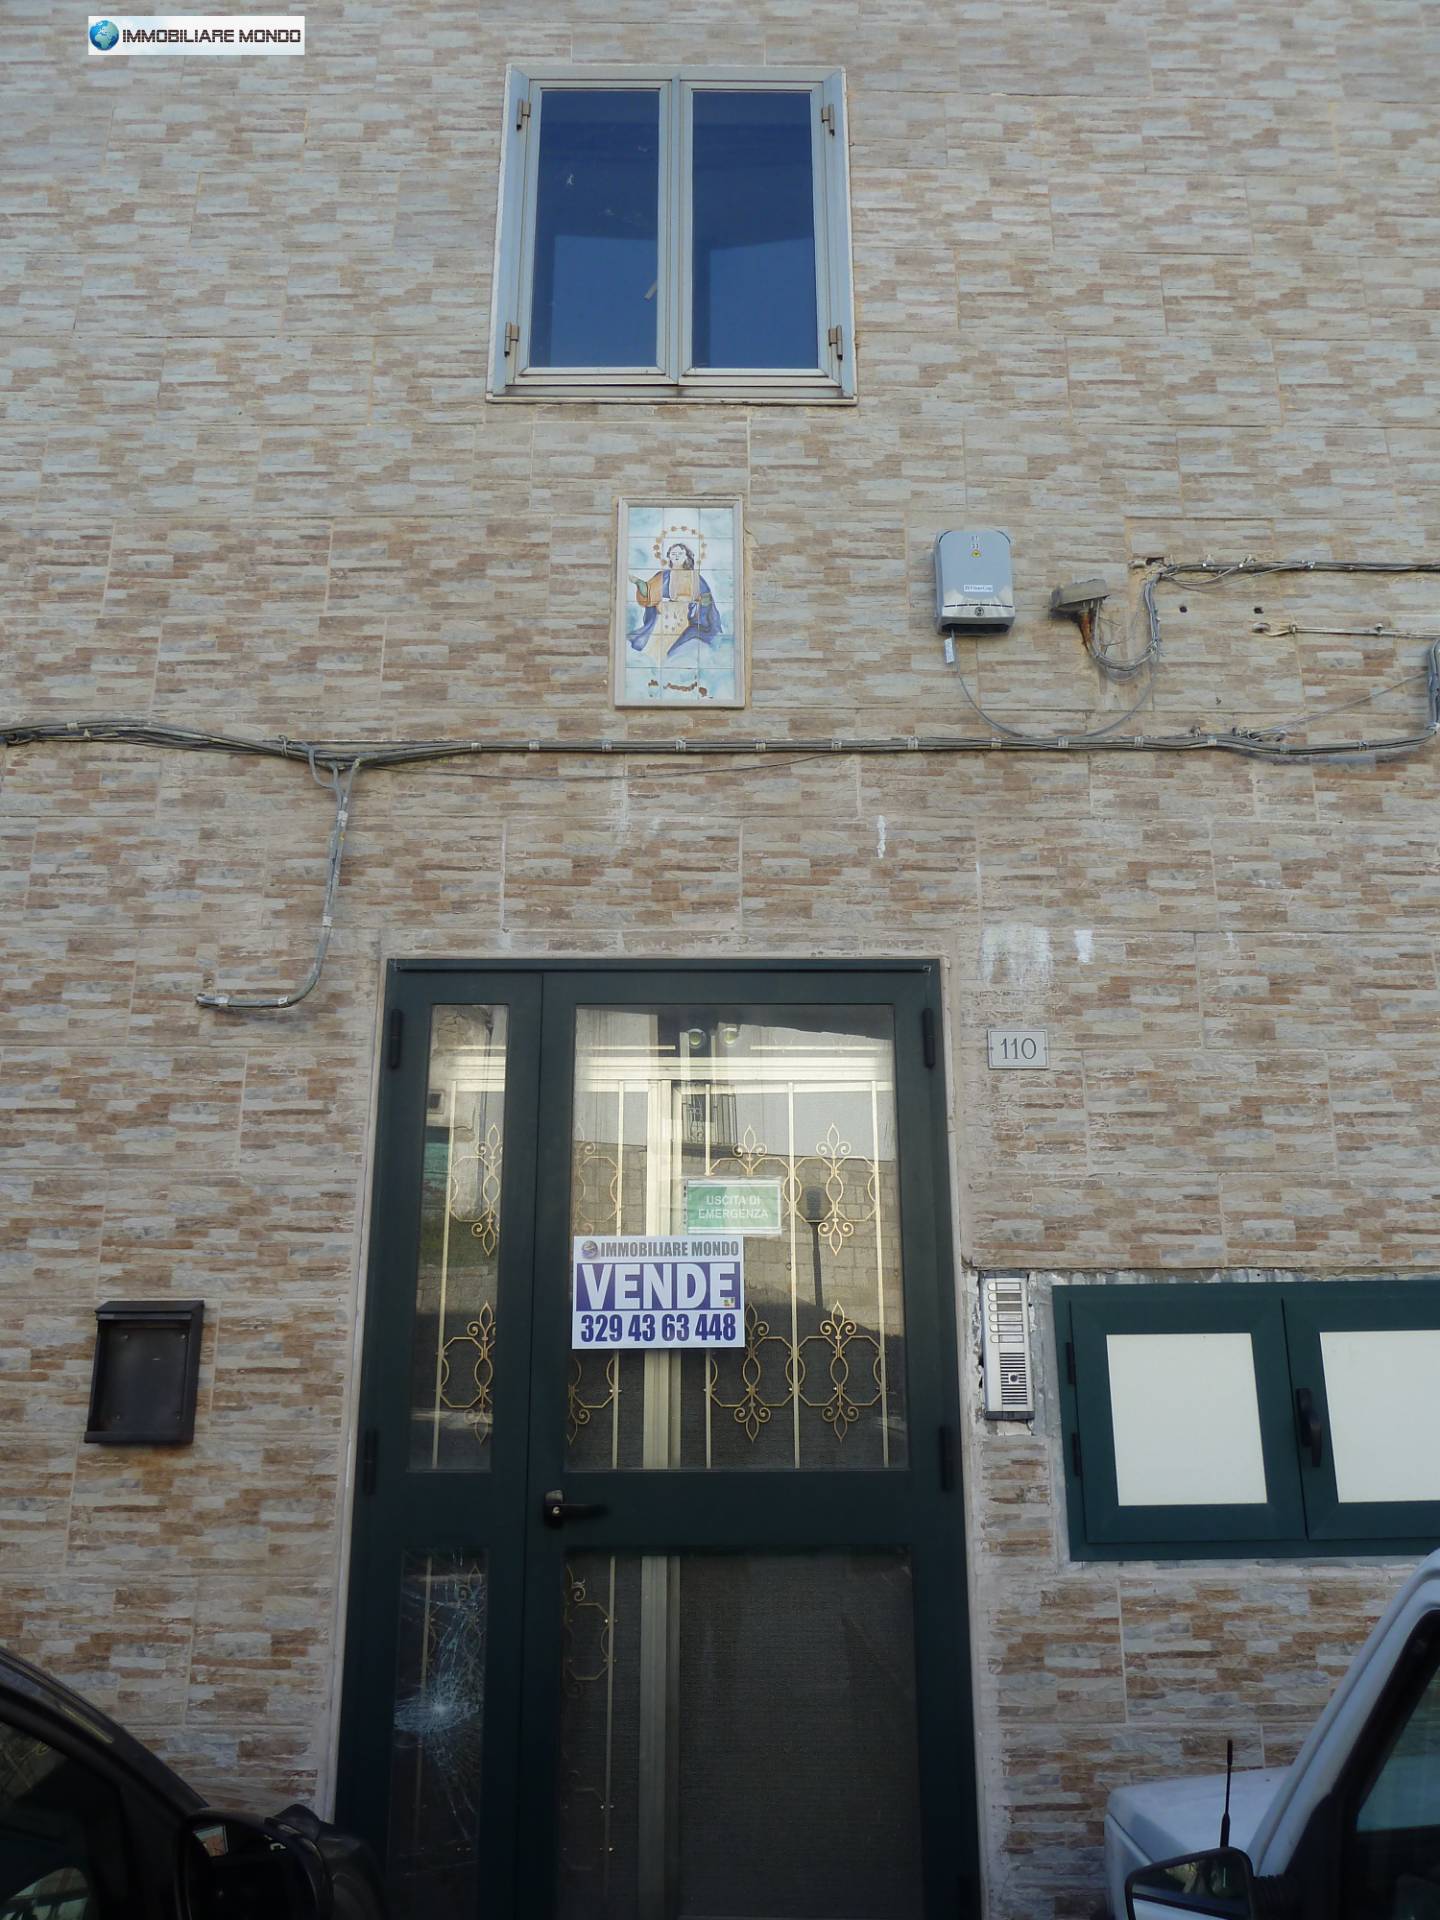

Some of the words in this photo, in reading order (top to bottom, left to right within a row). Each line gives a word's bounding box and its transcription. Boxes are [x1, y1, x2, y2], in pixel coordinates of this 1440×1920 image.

[1000, 1037, 1037, 1060] 110
[706, 1195, 746, 1206] USCITA
[750, 1195, 760, 1205] DI
[699, 1209, 769, 1219] EMERGENZA
[601, 1241, 688, 1257] IMMOBILIARE
[691, 1241, 739, 1256] MONDO
[582, 1263, 735, 1309] VENDE
[581, 1314, 623, 1342] 329
[628, 1314, 656, 1341] 43
[662, 1313, 689, 1341] 63
[695, 1313, 736, 1341] 448
